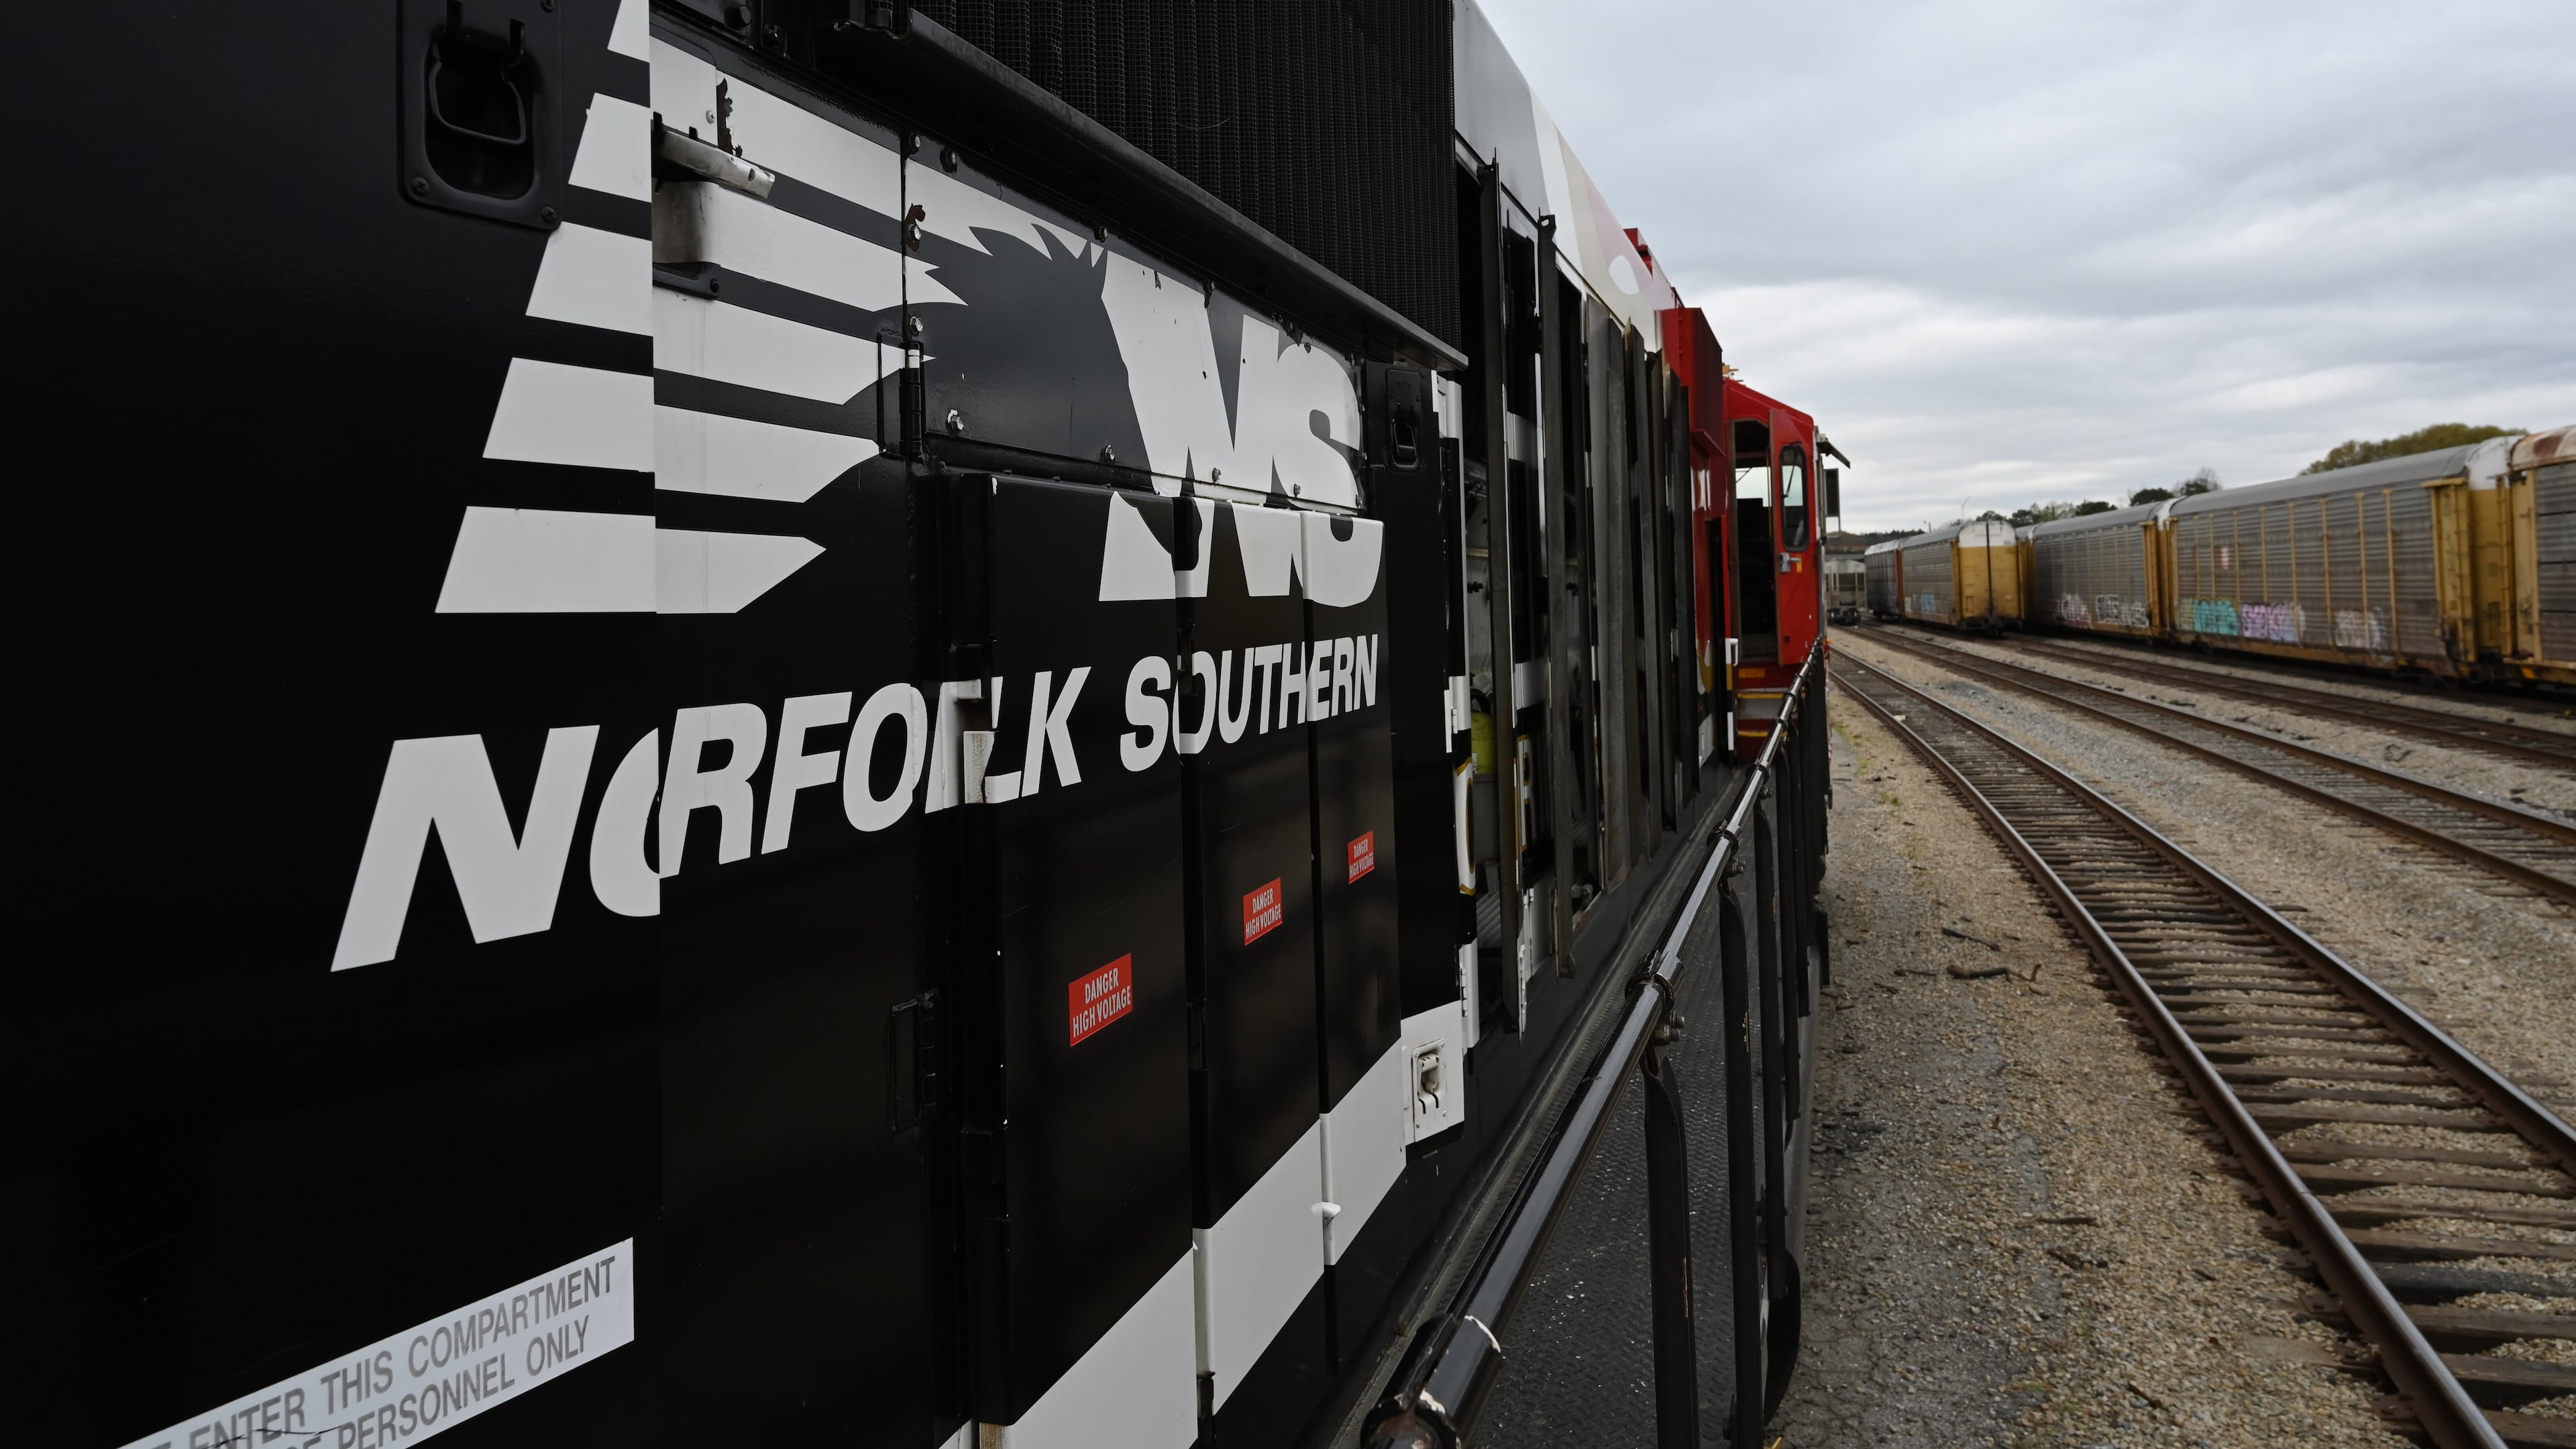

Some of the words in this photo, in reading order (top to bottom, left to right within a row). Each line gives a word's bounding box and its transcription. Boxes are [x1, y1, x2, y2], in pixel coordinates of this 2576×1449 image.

[331, 666, 1091, 972] NORFOLK
[1120, 634, 1379, 772] SOUTHERN
[1354, 839, 1368, 859] DANGER
[1246, 916, 1260, 939] HIGH
[1260, 903, 1281, 930] VOLTAGE
[1252, 888, 1273, 914] DANGER
[1085, 967, 1119, 1004] DANGER
[1073, 1006, 1095, 1038] HIGH
[1097, 985, 1131, 1023] VOLTAGE
[321, 1350, 393, 1415] THIS
[409, 1256, 616, 1378] COMPARTMENT
[338, 1353, 515, 1449] PERSONNEL
[527, 1315, 589, 1376] ONLY
